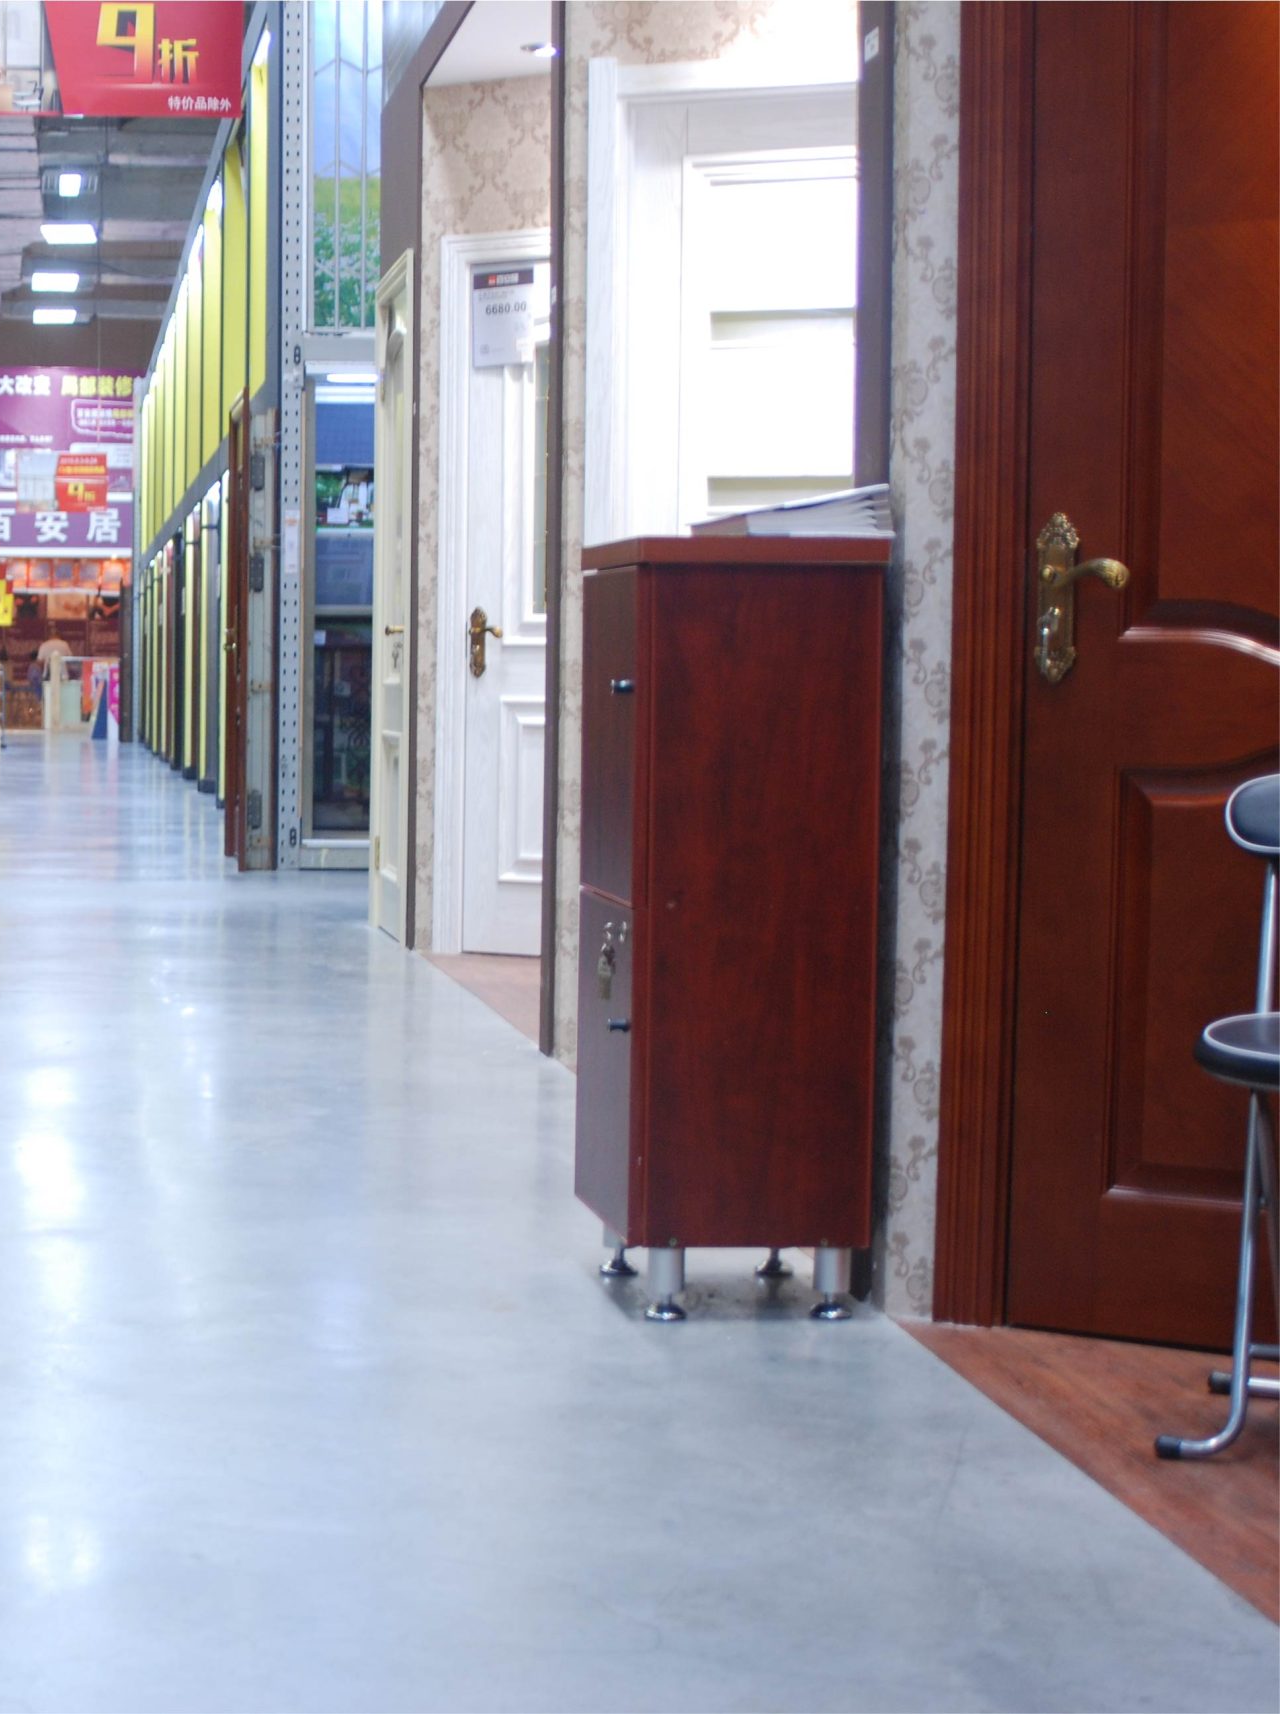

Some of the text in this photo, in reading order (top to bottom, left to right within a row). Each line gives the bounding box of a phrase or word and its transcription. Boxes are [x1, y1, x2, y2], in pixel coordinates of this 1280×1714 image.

[96, 2, 200, 84] 9折
[167, 96, 232, 112] 特价品除外
